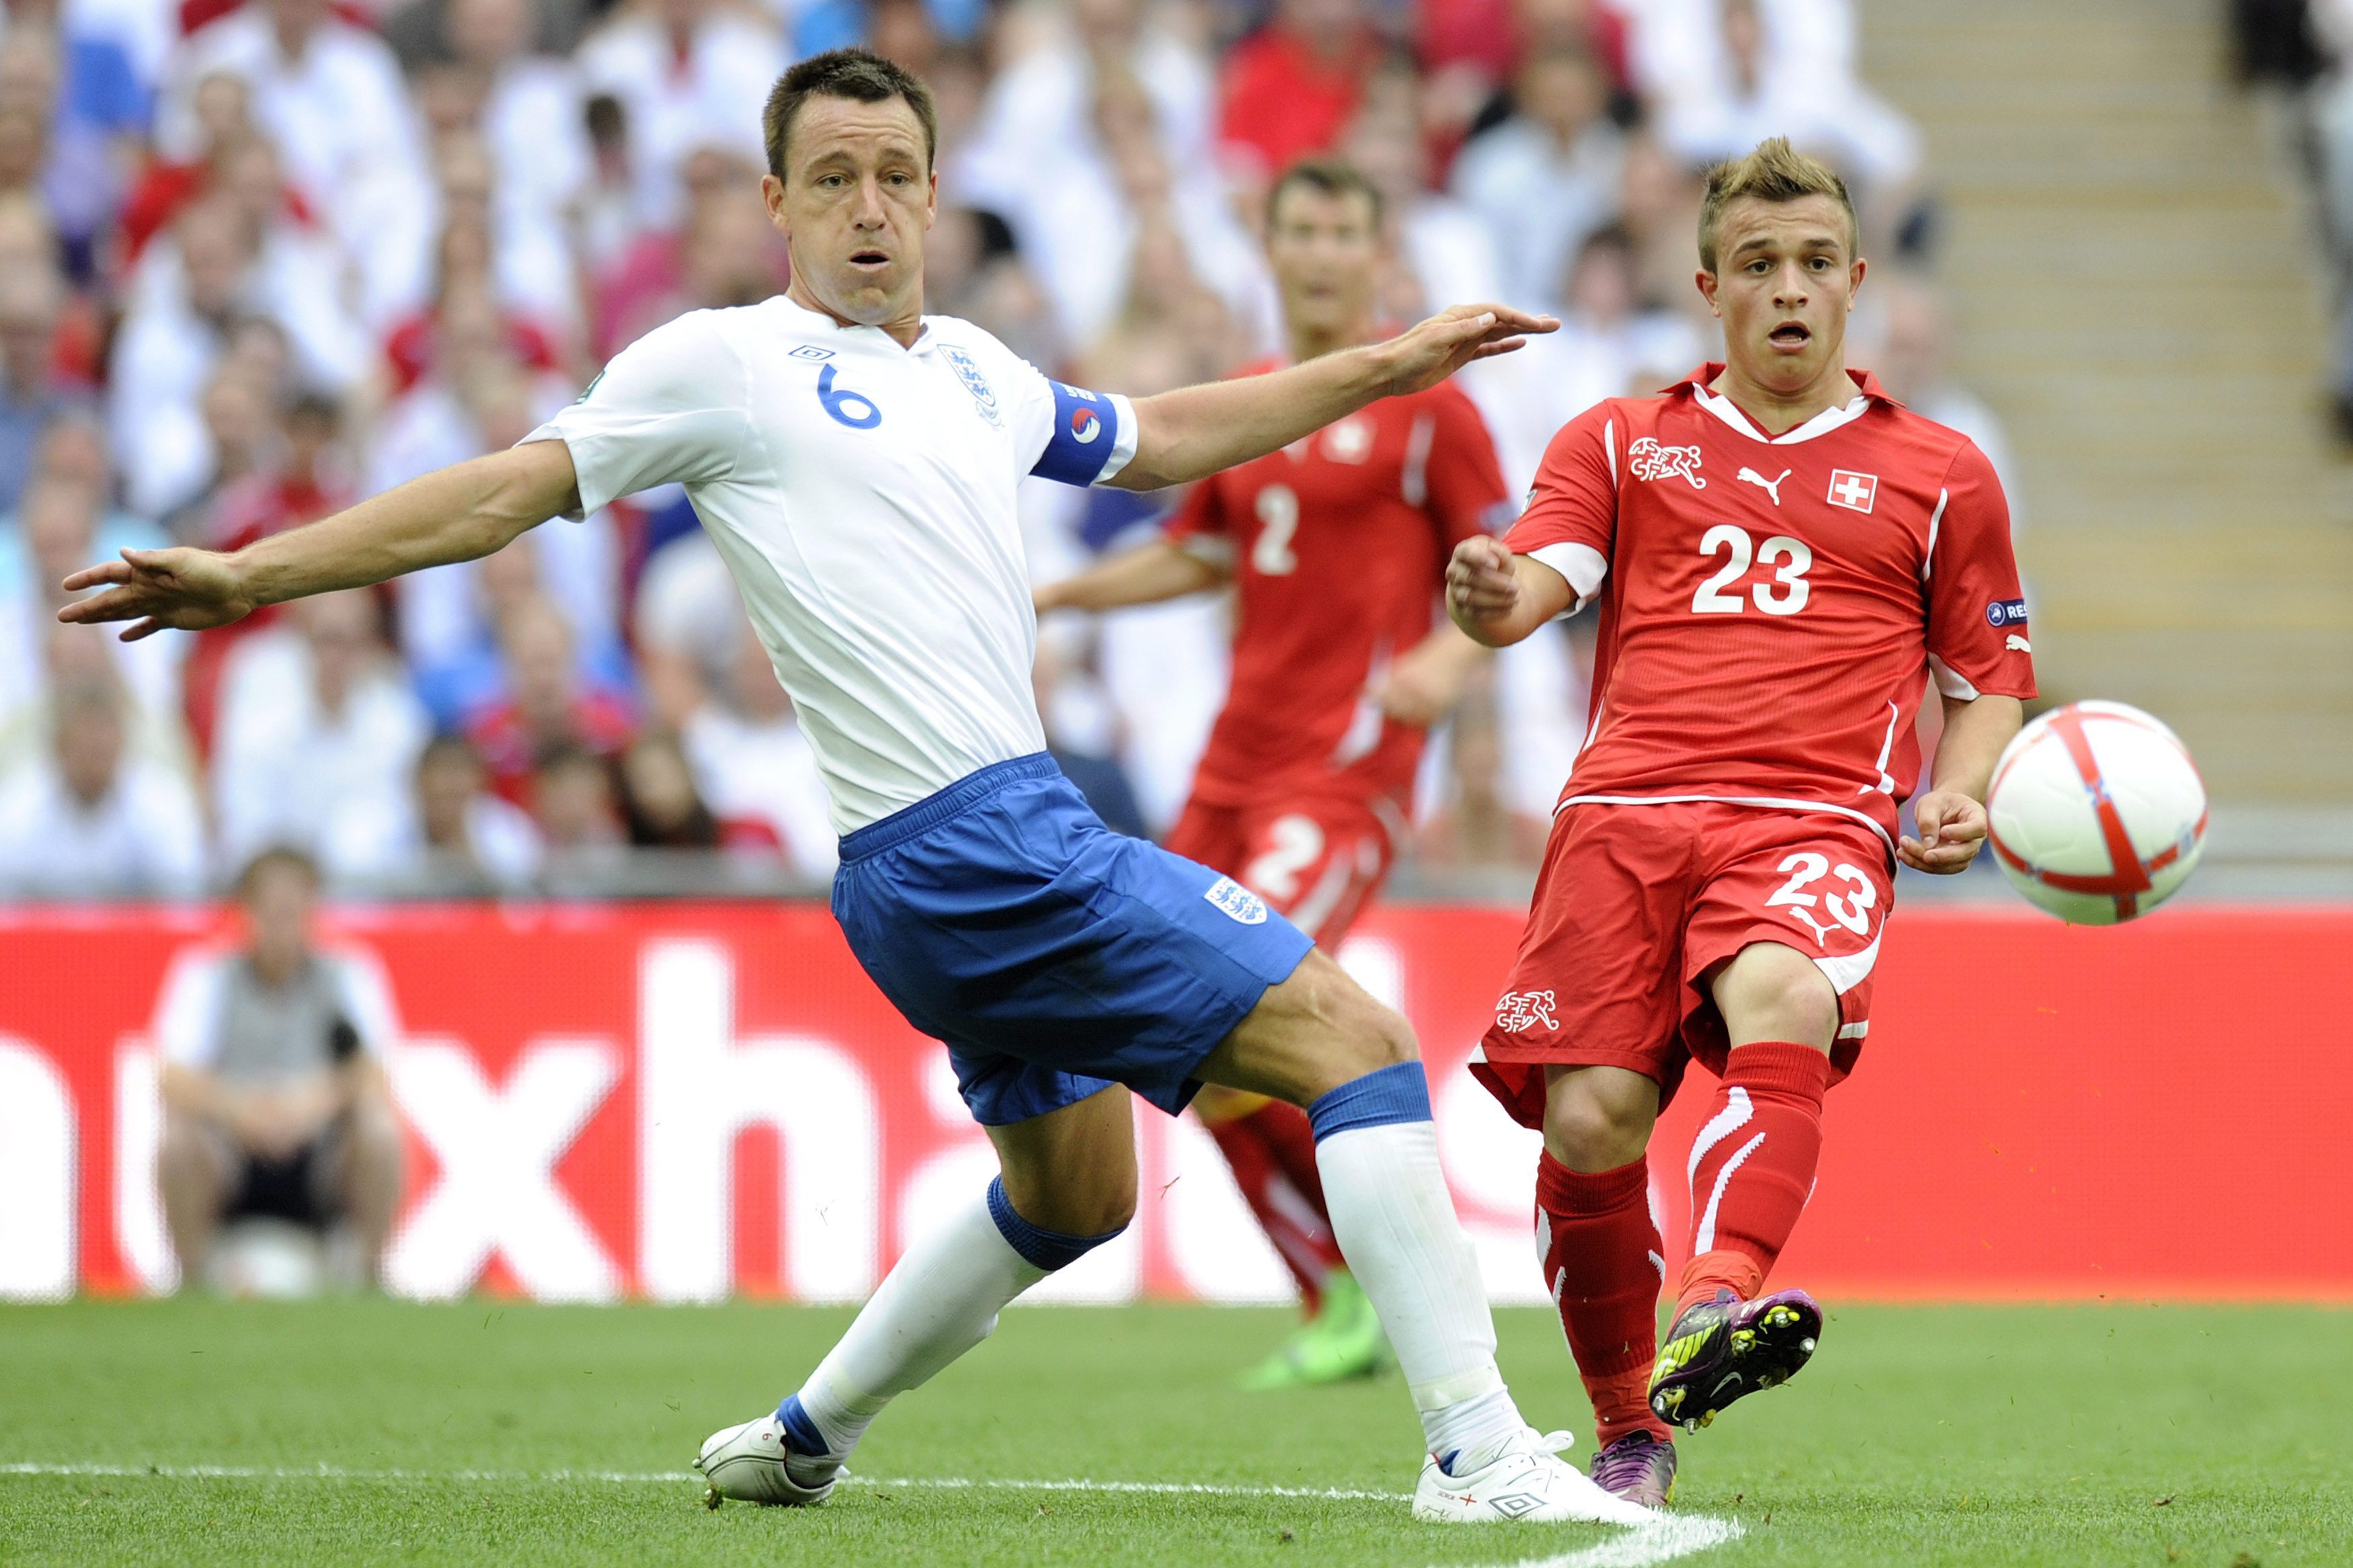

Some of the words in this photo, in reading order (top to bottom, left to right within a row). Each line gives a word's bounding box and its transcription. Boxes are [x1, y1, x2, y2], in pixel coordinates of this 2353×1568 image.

[817, 363, 882, 429] 6
[1252, 483, 1300, 577] 2
[1691, 524, 1812, 616] 23
[1245, 813, 1326, 901] 2
[1763, 852, 1878, 936] 23
